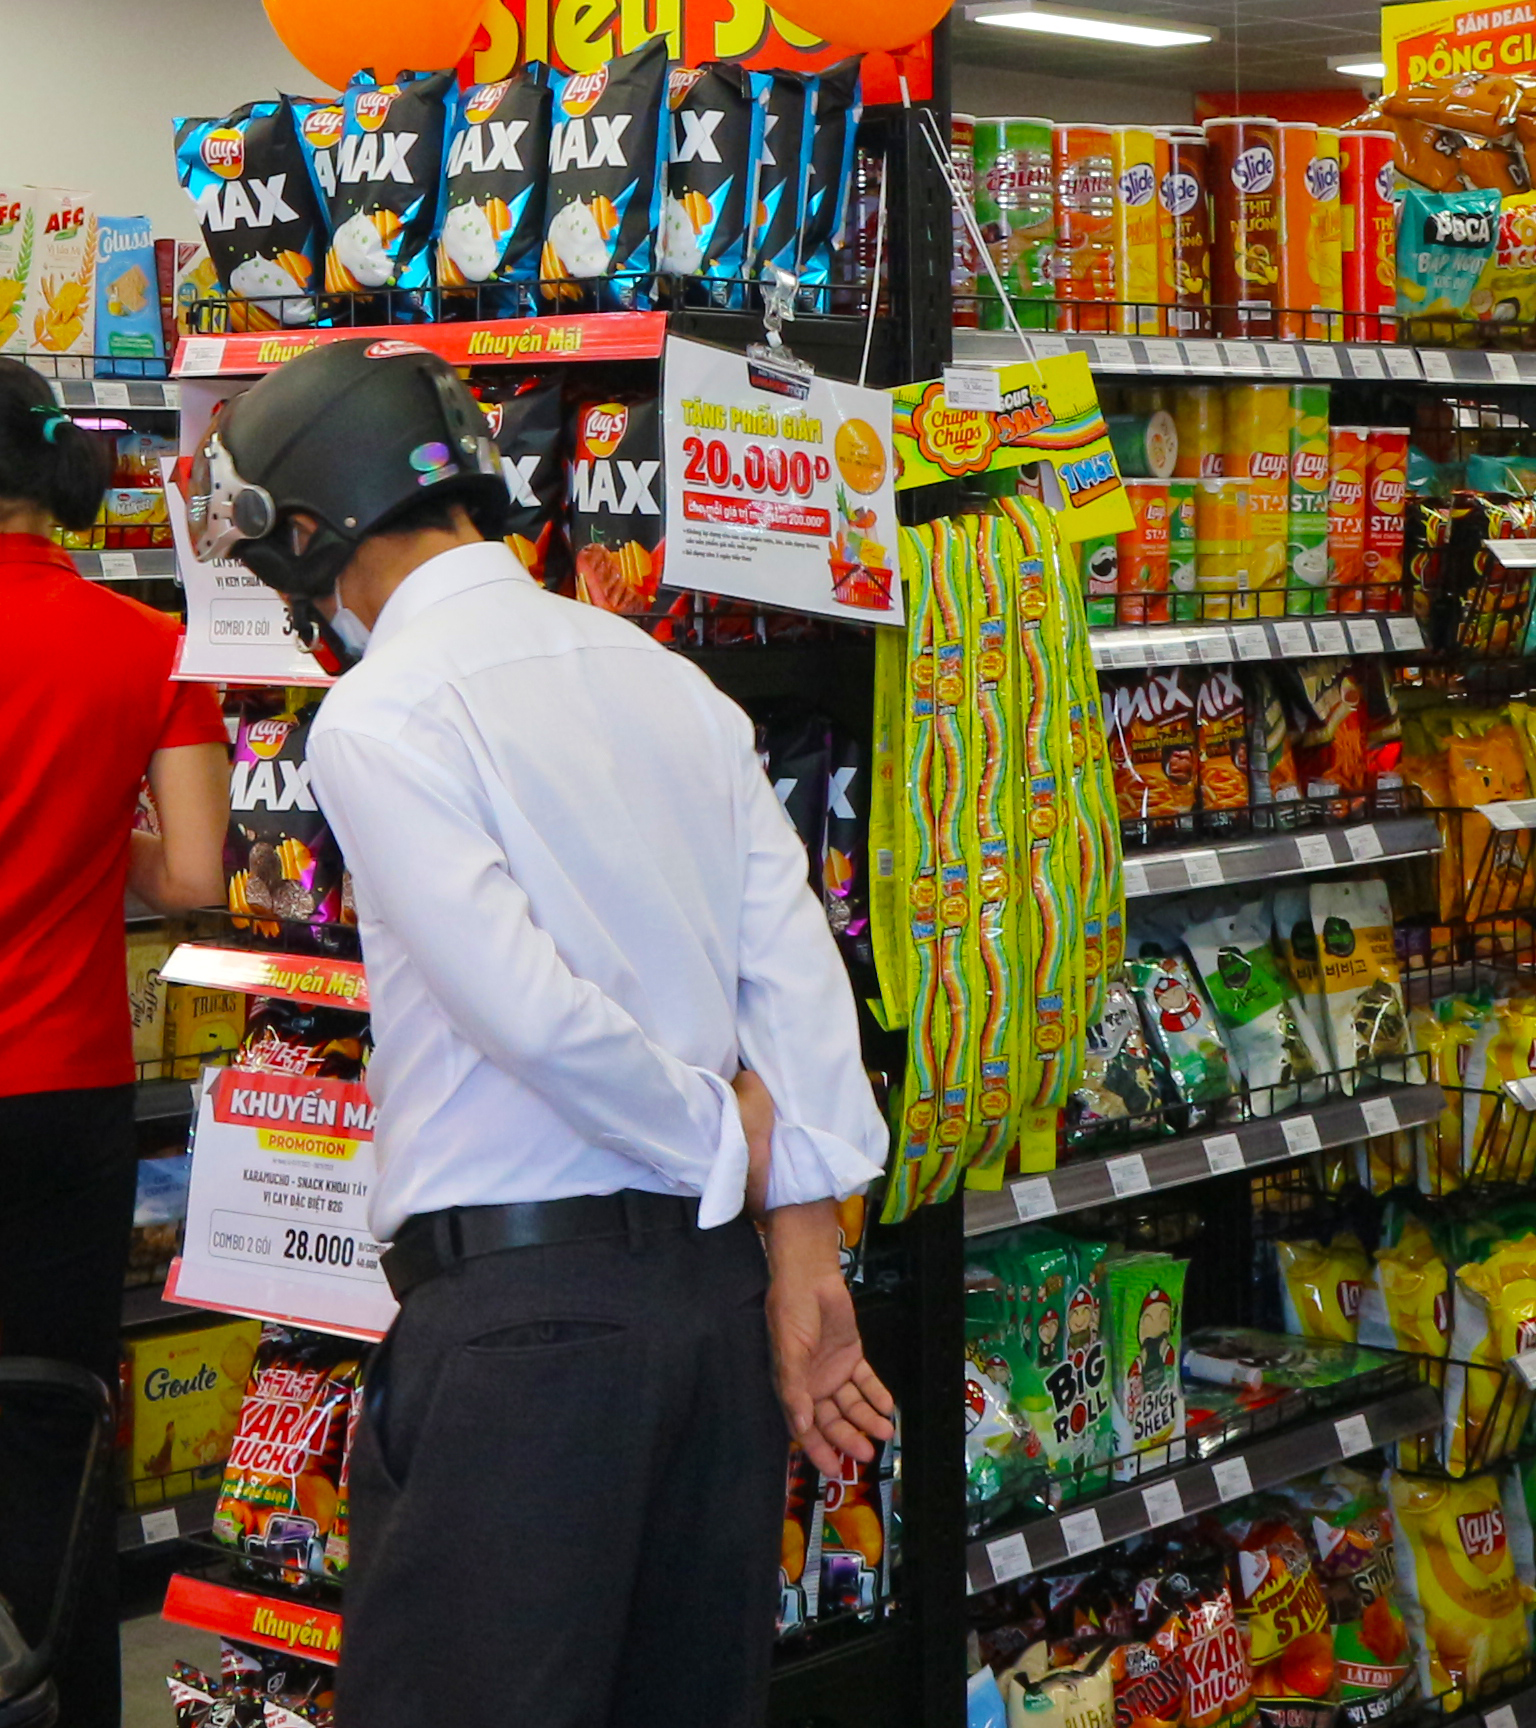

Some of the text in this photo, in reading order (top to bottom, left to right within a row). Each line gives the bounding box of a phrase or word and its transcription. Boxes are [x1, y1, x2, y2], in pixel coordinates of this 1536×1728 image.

[1457, 13, 1488, 36] SĂN
[1492, 5, 1535, 29] DEAL
[1409, 38, 1493, 82] ĐỒNG
[1234, 153, 1274, 186] Slide
[96, 227, 152, 262] Colussi
[469, 322, 583, 362] Khuyến Mãi
[681, 396, 823, 443] TẶNG PHIẾU GIẢM
[934, 426, 982, 448] Chups
[231, 760, 317, 812] MAX
[259, 964, 361, 998] Khuyến Mãi
[192, 993, 236, 1018] TRICKS
[230, 1088, 337, 1126] KHUYẾN
[268, 1135, 346, 1155] PROMOTION
[243, 1169, 367, 1196] KARAMUCHO SNACK KHOAI TÂY
[214, 1229, 354, 1267] COMBO 2 GÓI 28.000
[1053, 1395, 1107, 1443] ROLL
[252, 1608, 323, 1650] Khuyến
